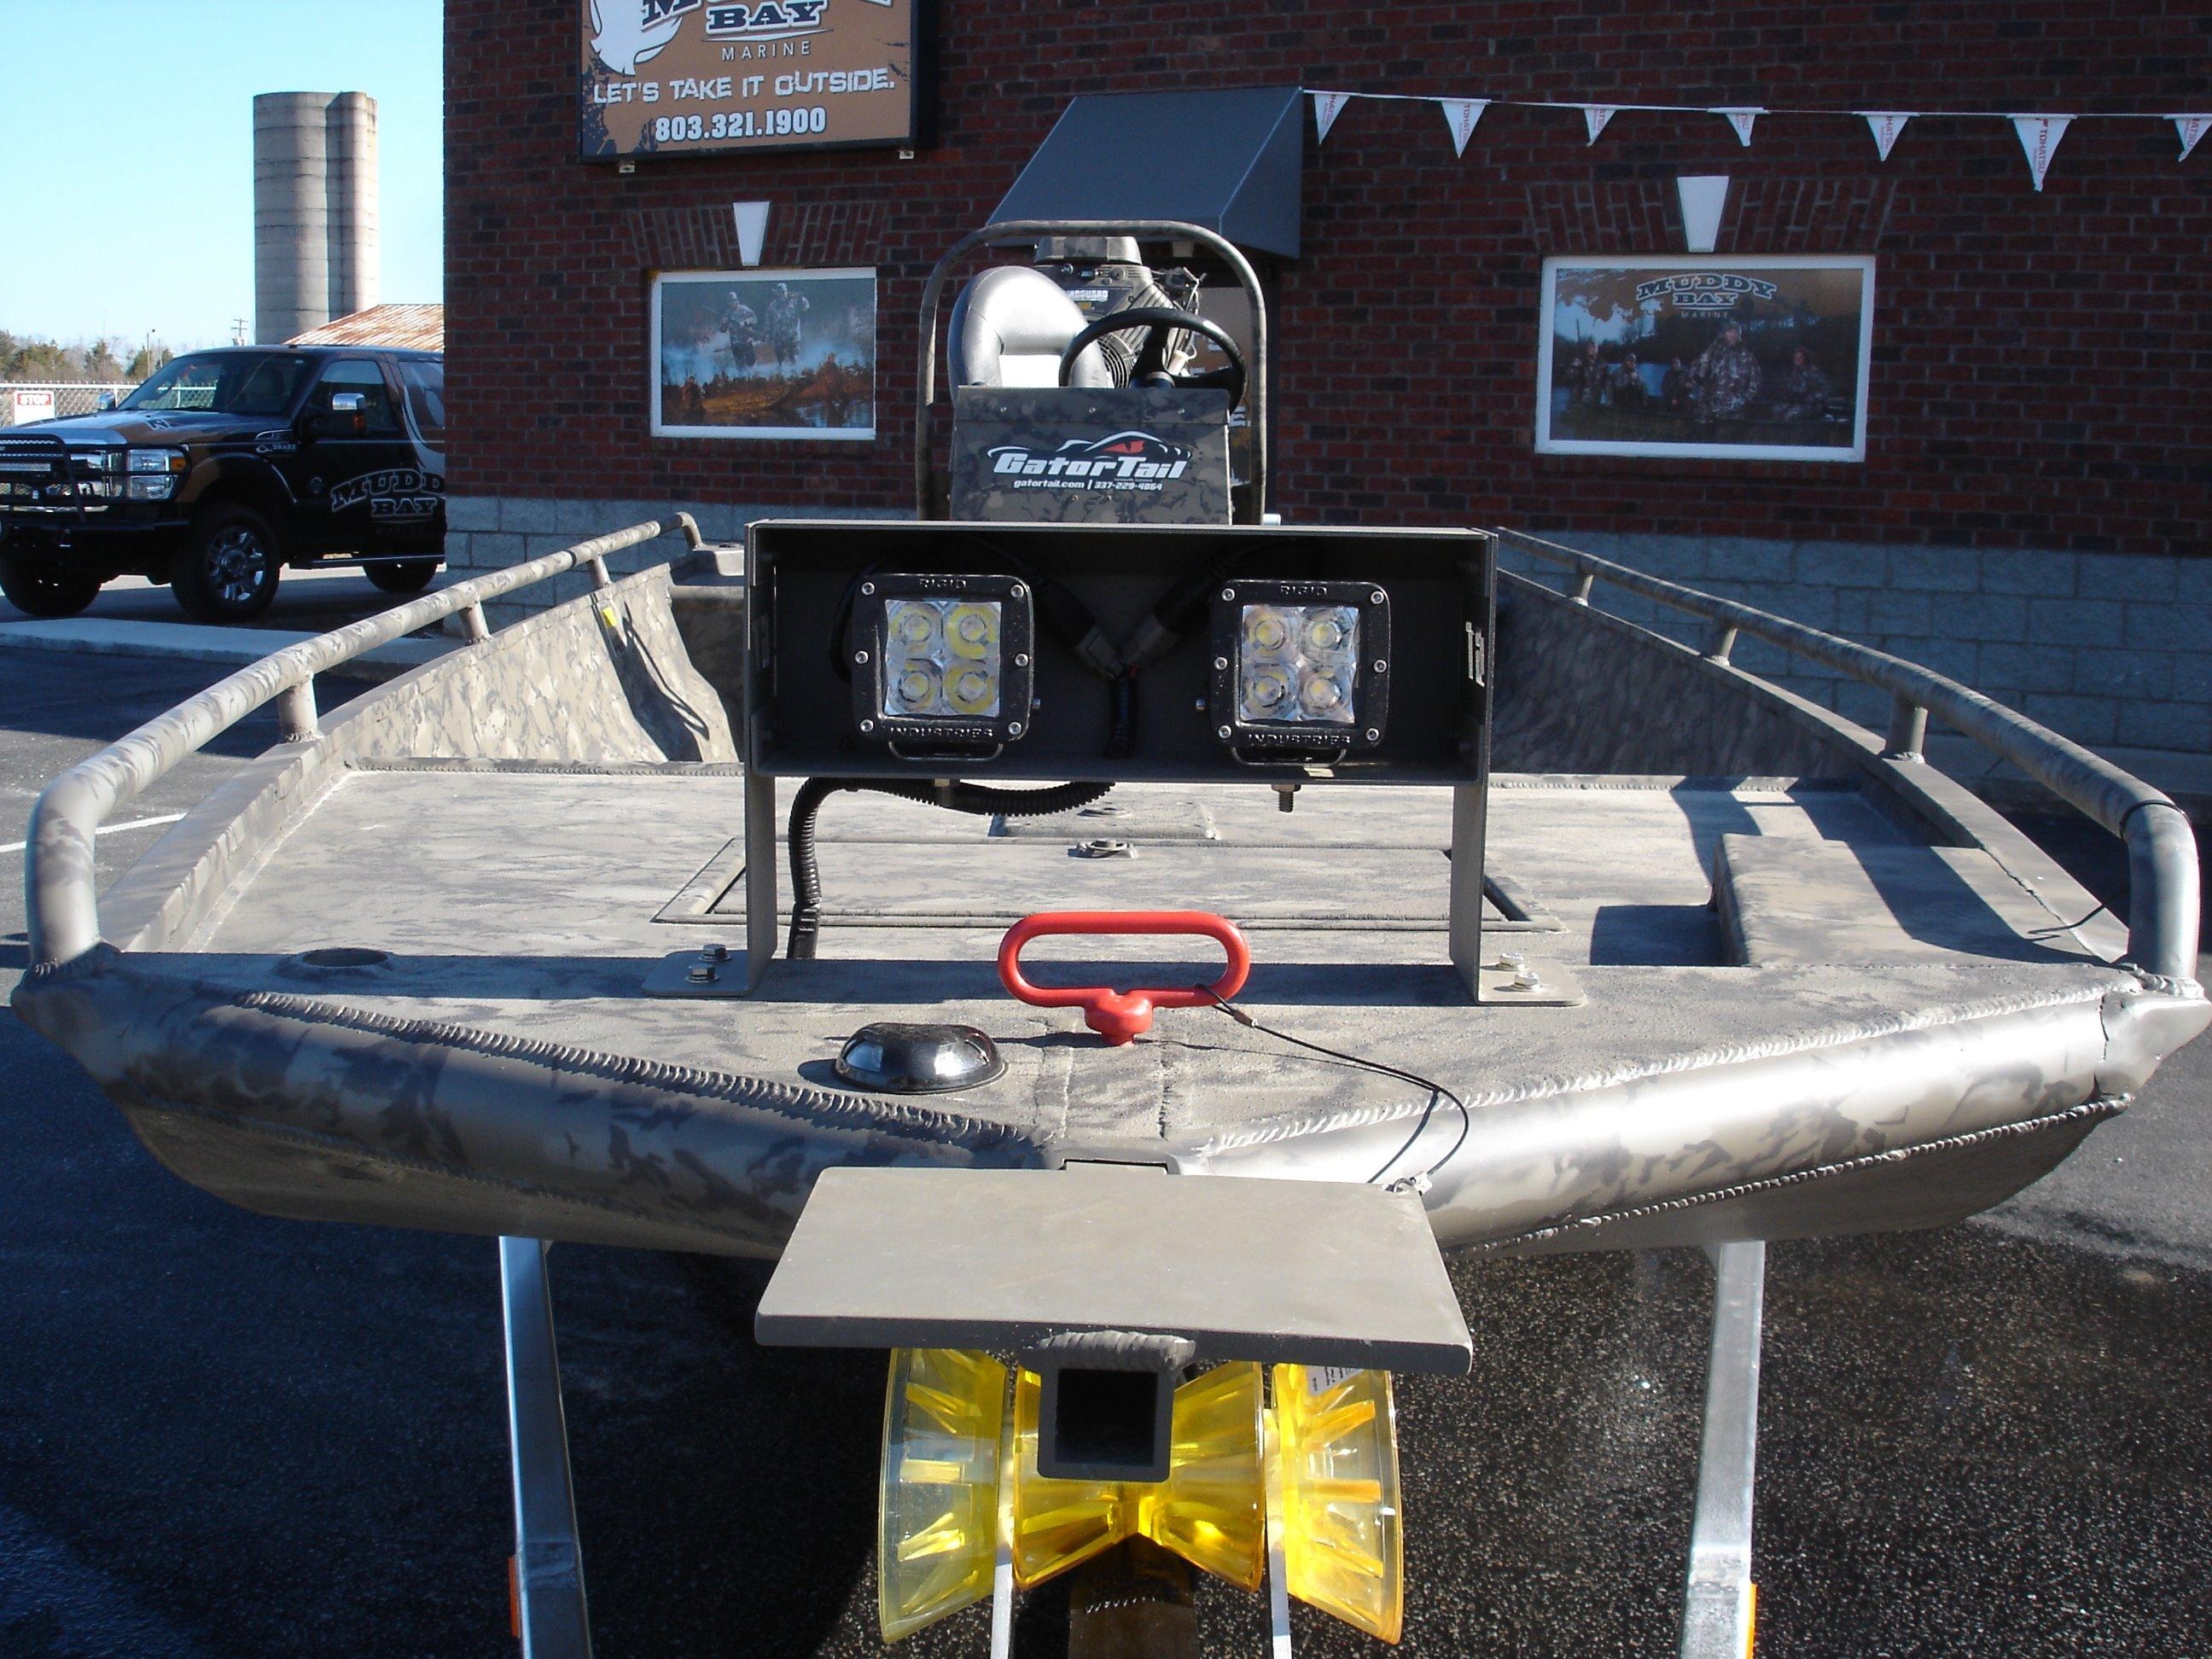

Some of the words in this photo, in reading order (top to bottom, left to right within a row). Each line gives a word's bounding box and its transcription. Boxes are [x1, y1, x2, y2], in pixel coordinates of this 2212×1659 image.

[706, 0, 827, 34] BAY
[721, 40, 812, 61] MARINE
[594, 81, 660, 104] LET'S
[670, 77, 732, 101] TAKE
[742, 75, 765, 98] IT
[774, 67, 895, 96] OUTSIDE.
[655, 107, 827, 142] 803.321.1900
[1066, 289, 1109, 301] ANGUARD
[1636, 272, 1778, 301] MUDDY
[1673, 292, 1739, 306] BAY
[1680, 311, 1729, 319] MARINE
[19, 393, 49, 405] STOP
[993, 452, 1188, 479] GatorTail
[329, 468, 446, 512] MUDD
[1013, 479, 1086, 489] gatortail.com
[370, 497, 438, 517] BAY
[1280, 585, 1328, 596] RIGID
